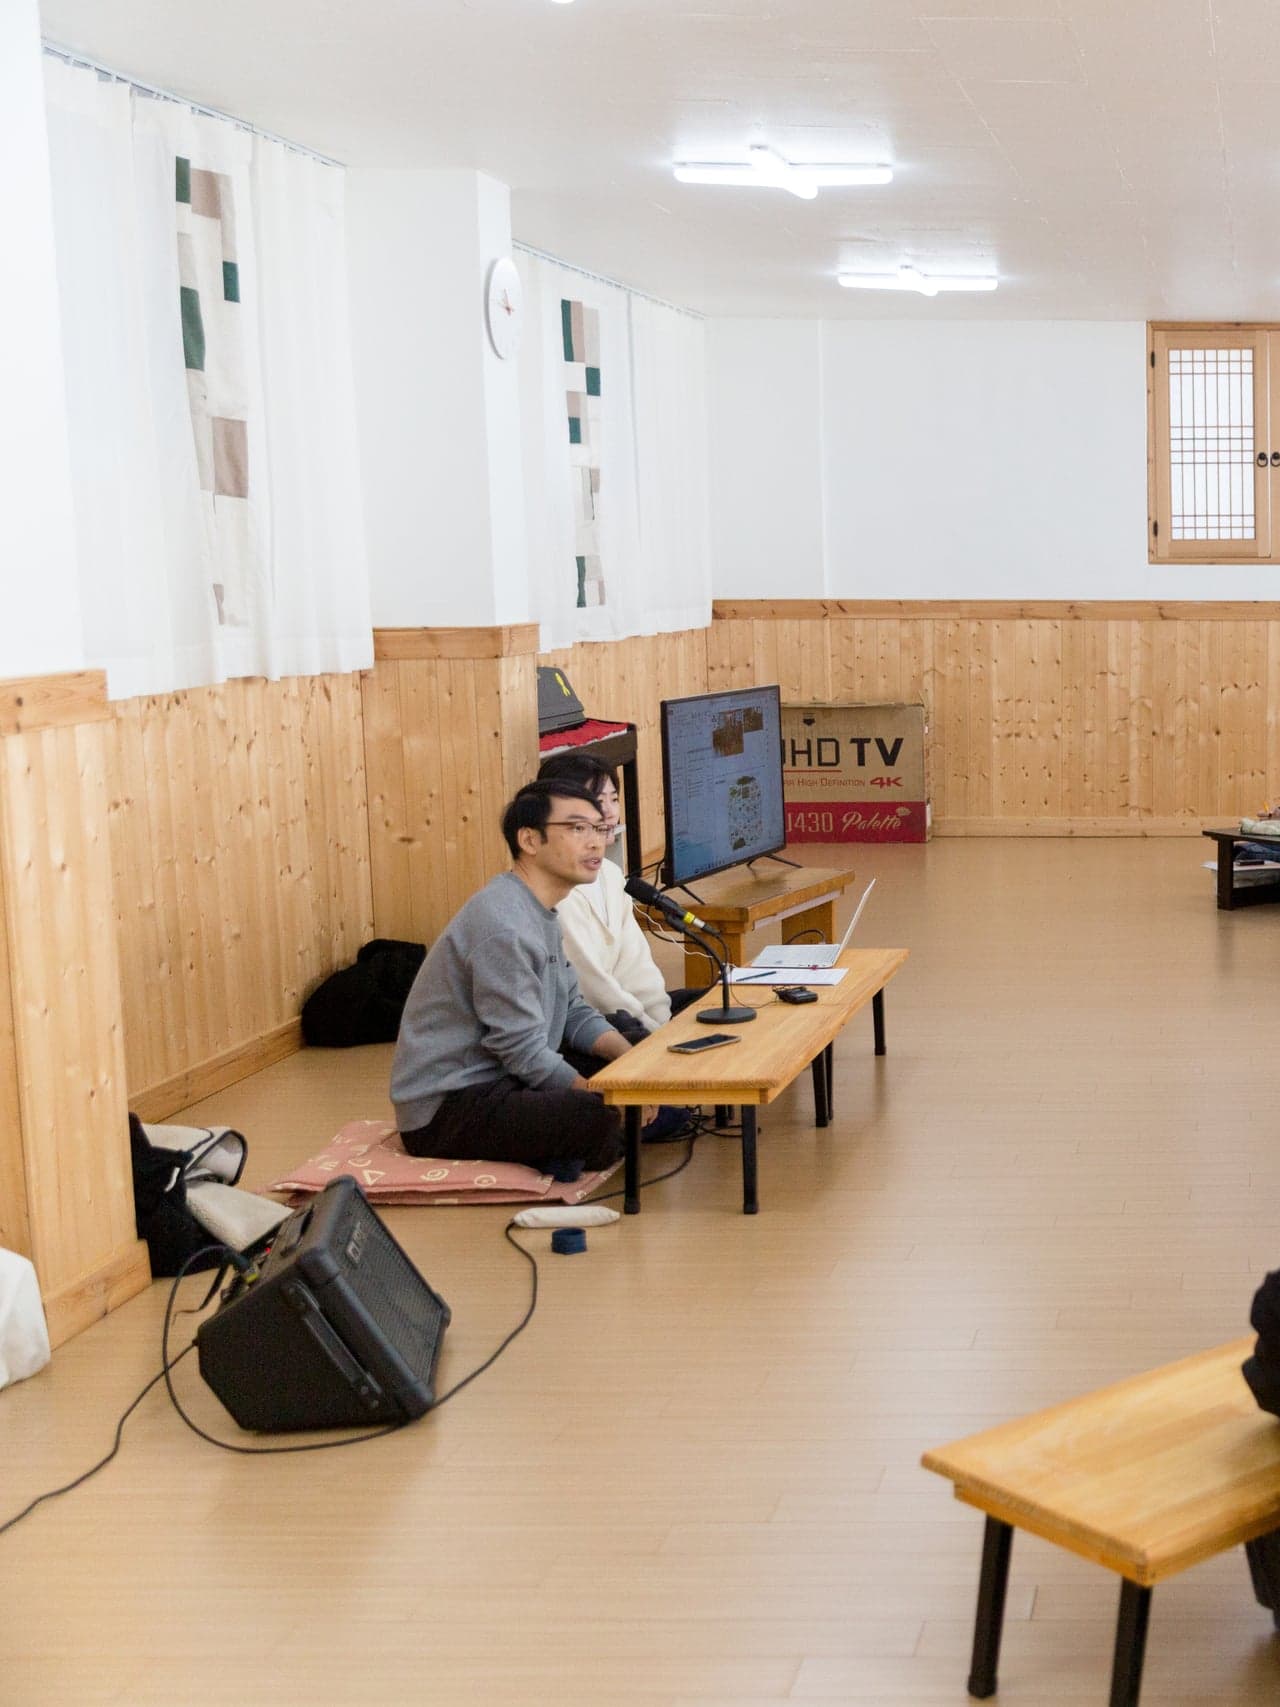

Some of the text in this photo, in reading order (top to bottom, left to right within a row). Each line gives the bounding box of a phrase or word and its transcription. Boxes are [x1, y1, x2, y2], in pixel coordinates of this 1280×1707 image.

[849, 737, 904, 767] TV
[869, 777, 903, 789] 4K
[842, 811, 901, 833] Palette
